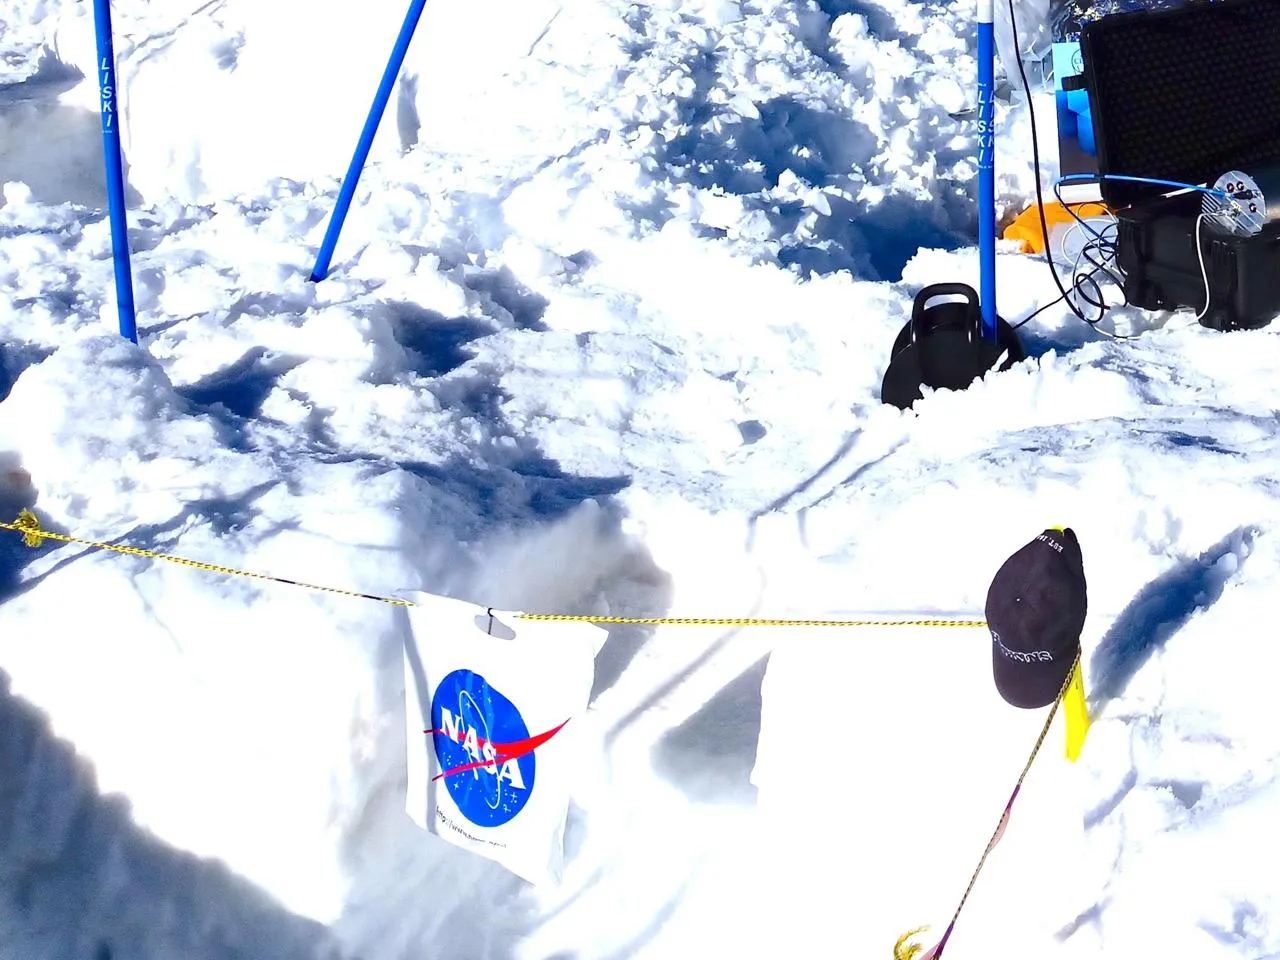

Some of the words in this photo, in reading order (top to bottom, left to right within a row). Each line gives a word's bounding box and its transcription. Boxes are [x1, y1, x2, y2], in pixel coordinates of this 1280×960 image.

[100, 56, 113, 128] LISKI
[977, 89, 987, 162] LISKI
[440, 705, 527, 791] NASA
